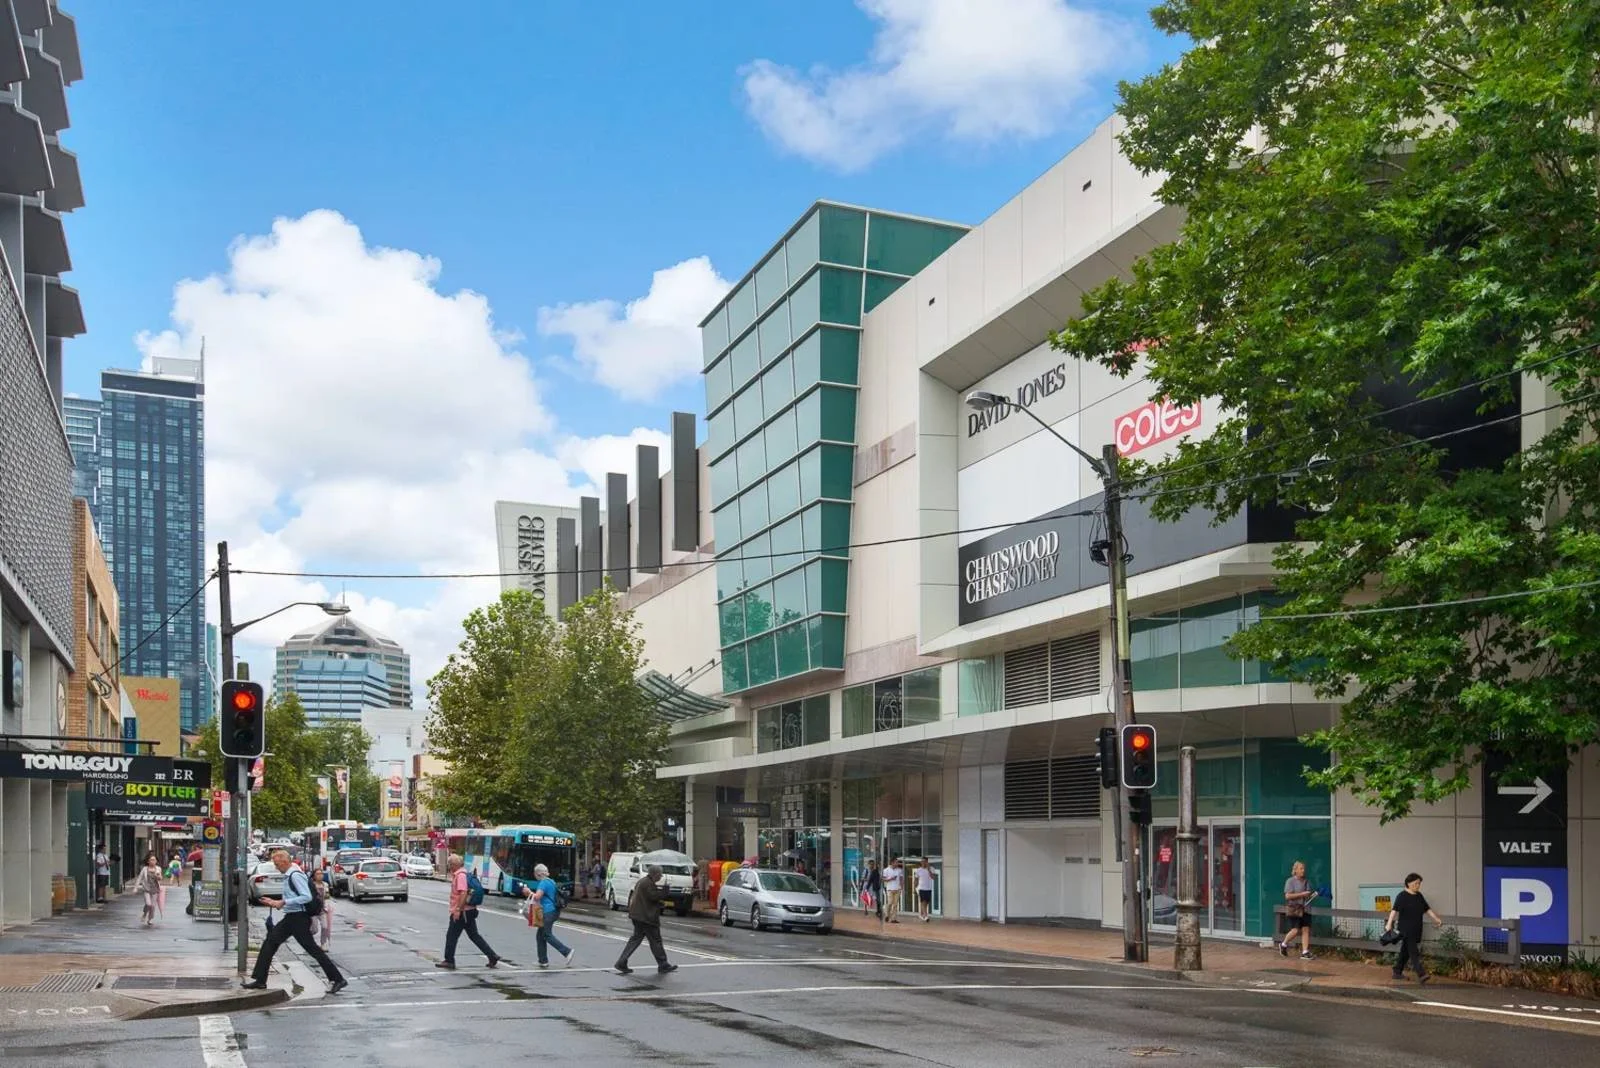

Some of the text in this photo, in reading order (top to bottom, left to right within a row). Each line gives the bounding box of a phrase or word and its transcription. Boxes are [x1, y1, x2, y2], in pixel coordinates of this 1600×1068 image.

[968, 363, 1066, 438] DAVID JONES
[1117, 399, 1199, 452] coles
[518, 515, 532, 571] CHASE
[531, 516, 546, 601] CHATSWO
[966, 531, 1059, 583] CHATSWOOD
[22, 753, 134, 773] TONI&GUY
[173, 769, 194, 781] ER
[90, 782, 196, 798] little BOTTLER
[1499, 842, 1552, 854] VALET
[1501, 878, 1553, 930] P
[1520, 954, 1562, 963] SWOOD
